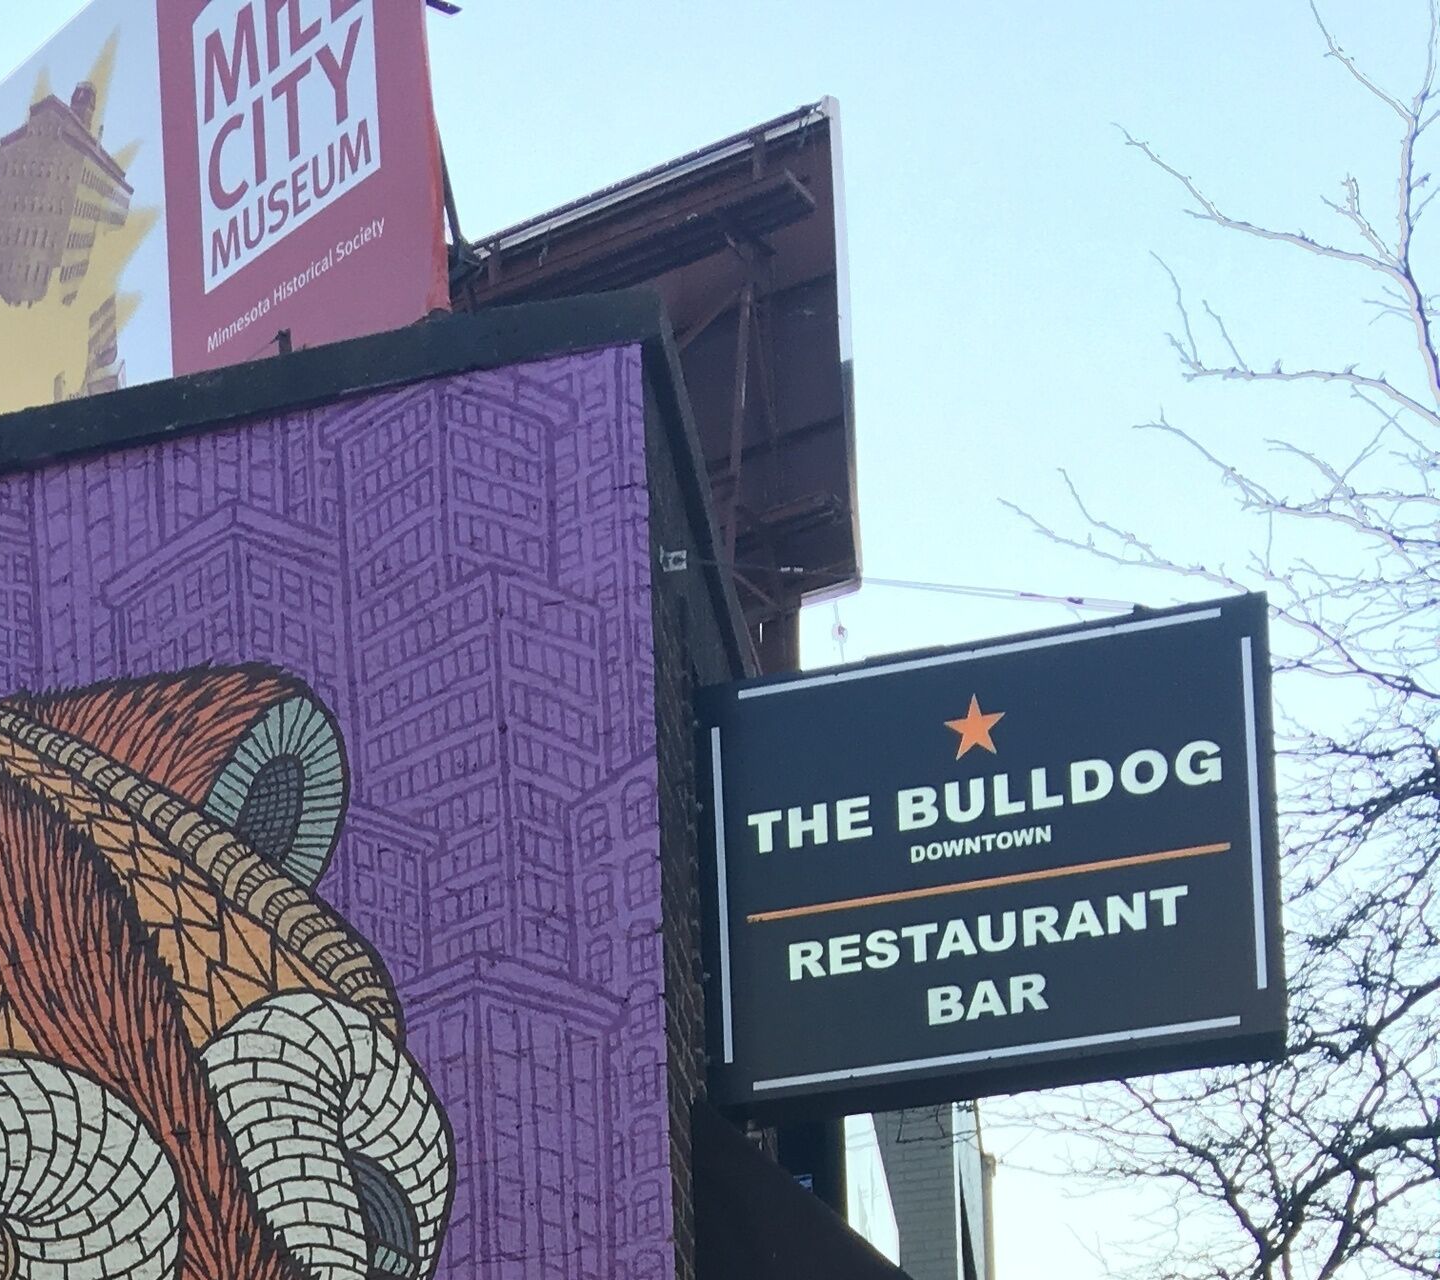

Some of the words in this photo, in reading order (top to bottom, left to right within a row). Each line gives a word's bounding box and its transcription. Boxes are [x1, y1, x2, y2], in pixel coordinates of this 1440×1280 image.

[203, 0, 363, 125] MIL
[208, 15, 364, 211] CITY
[211, 118, 372, 278] MUSEUM
[207, 298, 270, 353] Minnesota
[273, 249, 333, 307] Historical
[336, 217, 385, 263] Society
[747, 795, 874, 854] THE
[897, 740, 1223, 832] BULLDOG
[910, 825, 1053, 864] DOWNTOWN
[788, 885, 1189, 981] RESTAURANT
[927, 972, 1049, 1026] BAR
